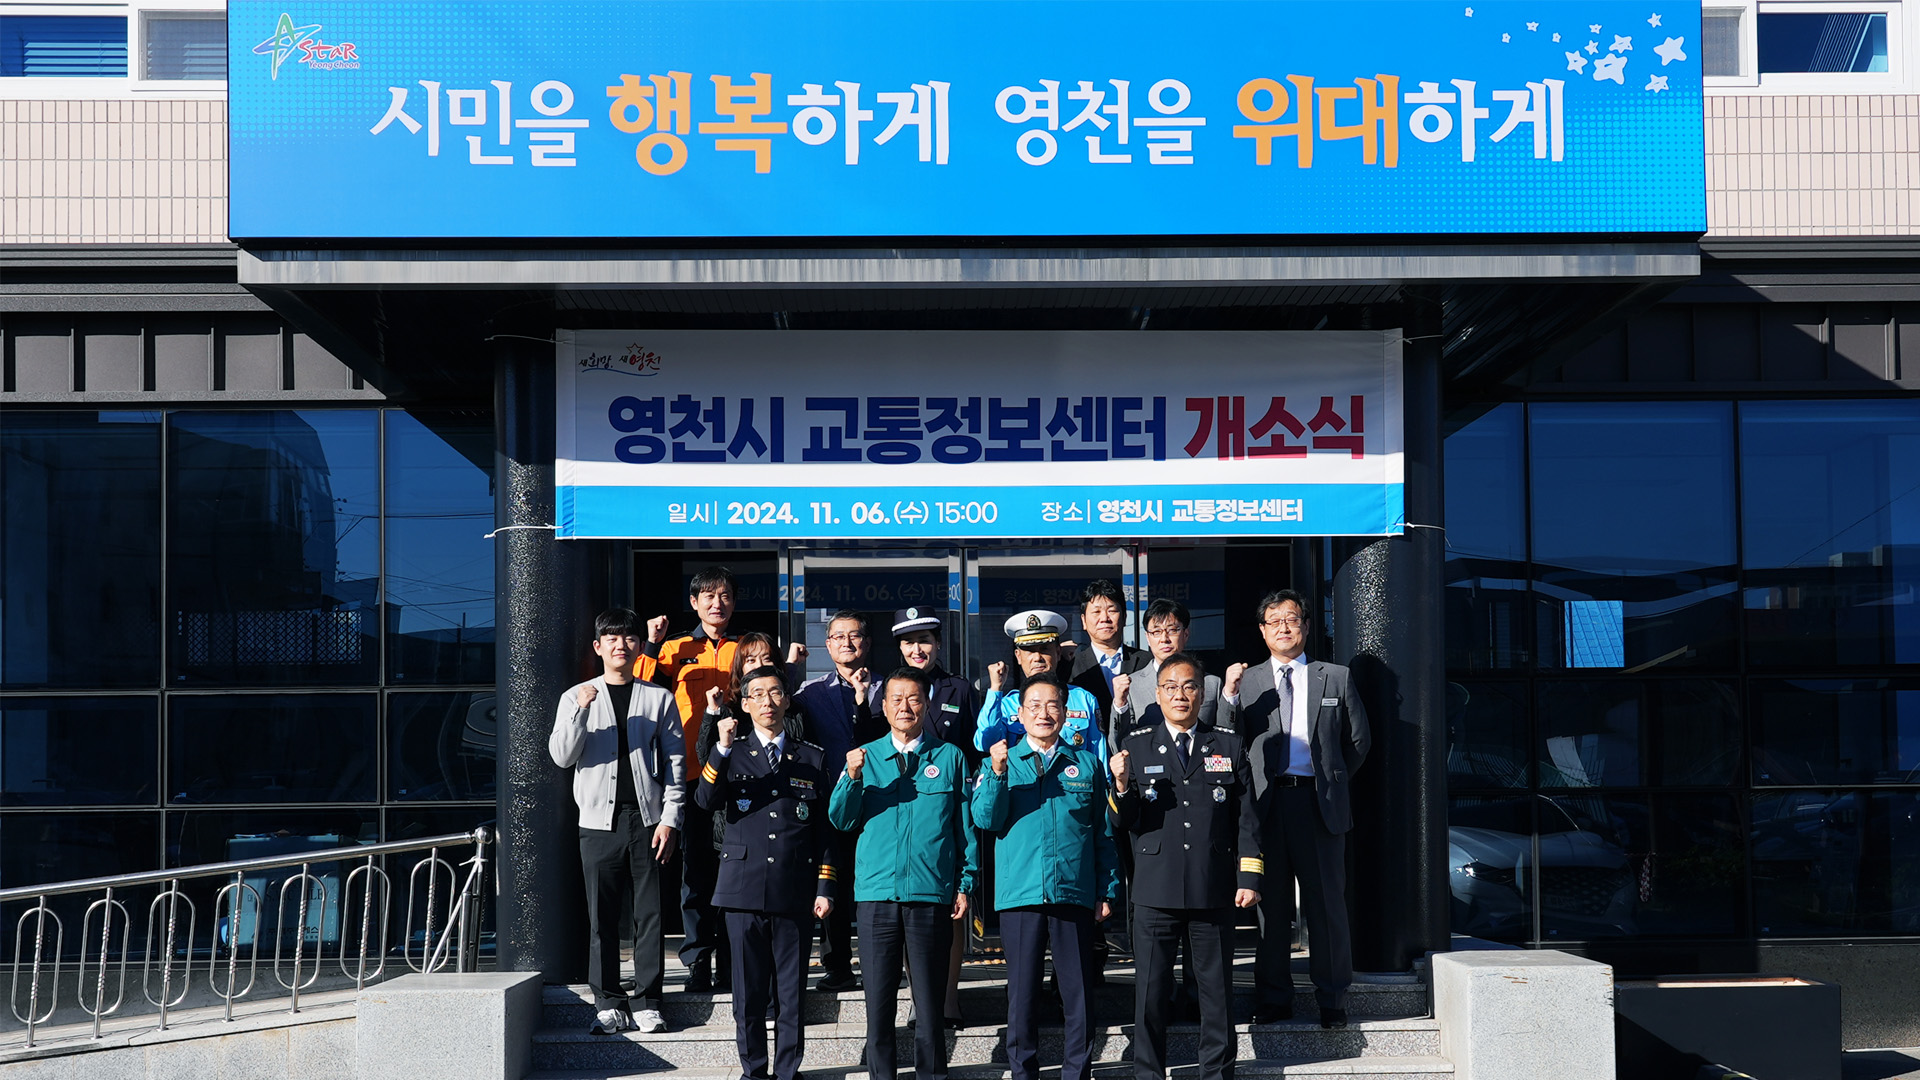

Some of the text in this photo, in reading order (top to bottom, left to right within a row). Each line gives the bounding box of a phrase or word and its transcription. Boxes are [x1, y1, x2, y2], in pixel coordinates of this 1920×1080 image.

[369, 71, 1566, 176] 시민을 행복하게 영천을 위대하게
[608, 394, 1364, 465] 영천시 교통정보센터 개소식
[727, 501, 800, 525] 2024.
[809, 501, 841, 525] 11.
[934, 501, 998, 525] 15:00
[1097, 499, 1163, 523] 영천시
[1171, 498, 1303, 523] 교통정보센터
